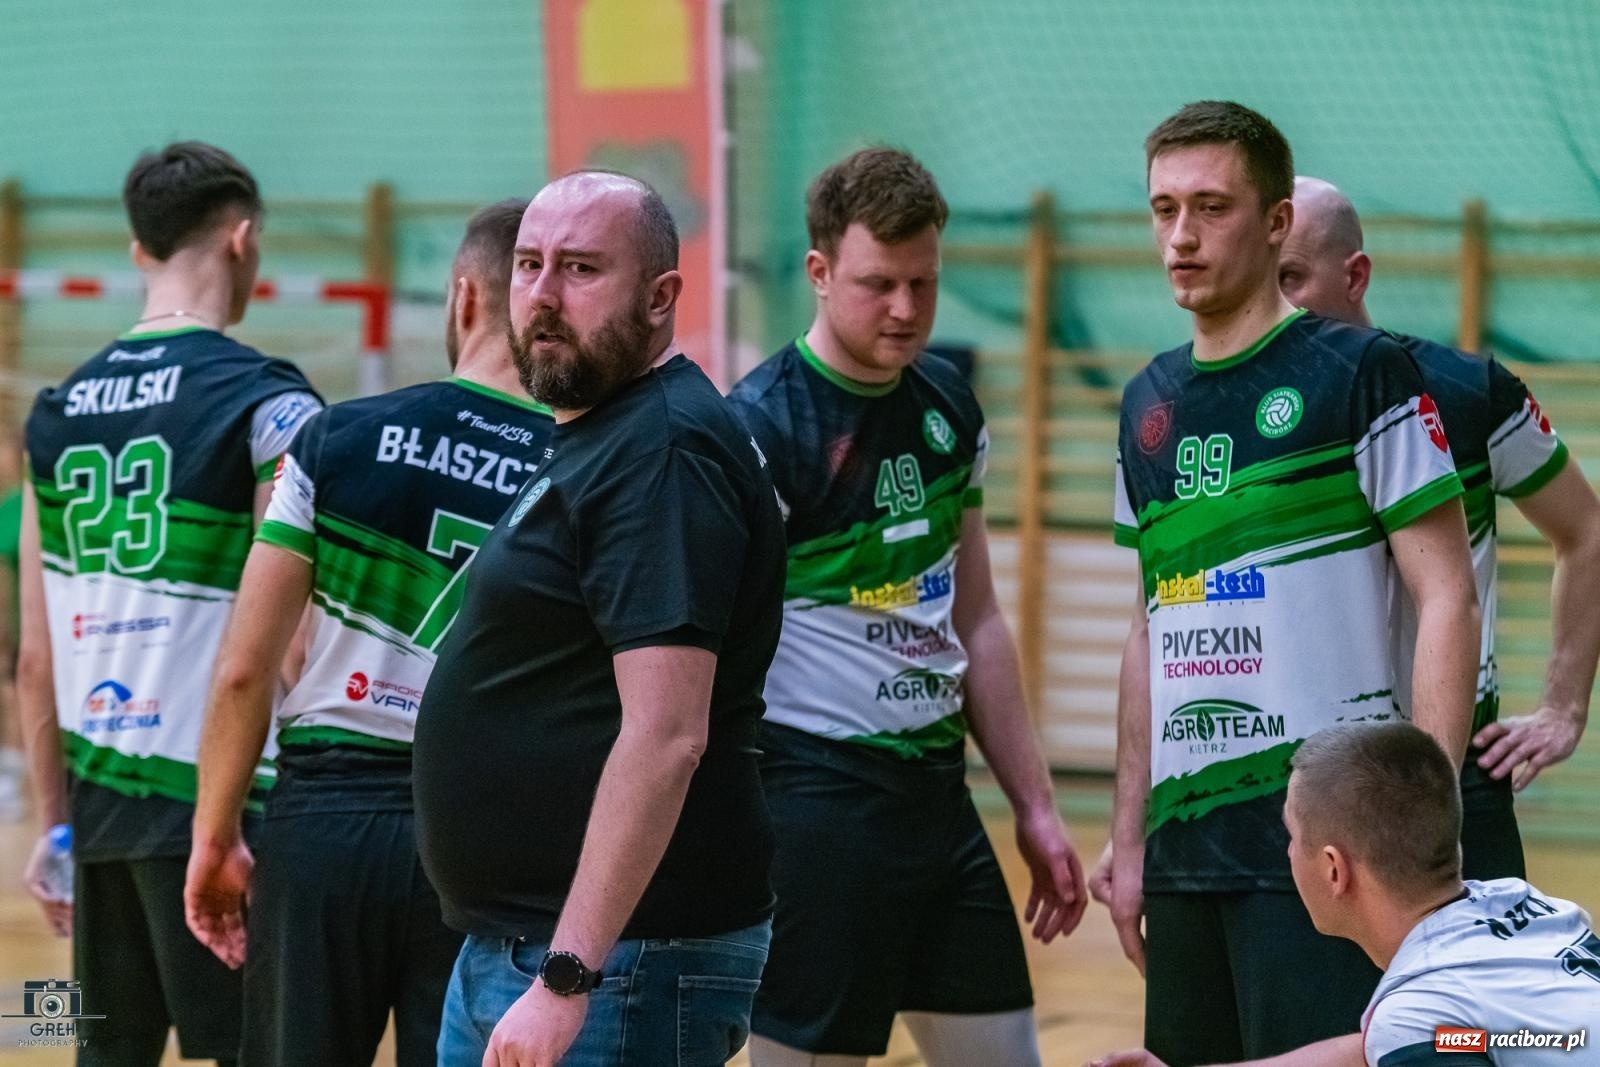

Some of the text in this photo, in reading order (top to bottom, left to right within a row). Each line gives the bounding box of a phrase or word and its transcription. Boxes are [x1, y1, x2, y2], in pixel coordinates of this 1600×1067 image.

[64, 365, 183, 417] SKULSKI
[456, 409, 534, 446] #TeamKSR
[874, 452, 926, 517] 49
[1174, 433, 1234, 500] 99
[54, 434, 173, 574] 23
[1156, 565, 1265, 600] instal-tech
[1162, 625, 1263, 660] PIVEXIN
[1163, 658, 1263, 680] TECHNOLOGY
